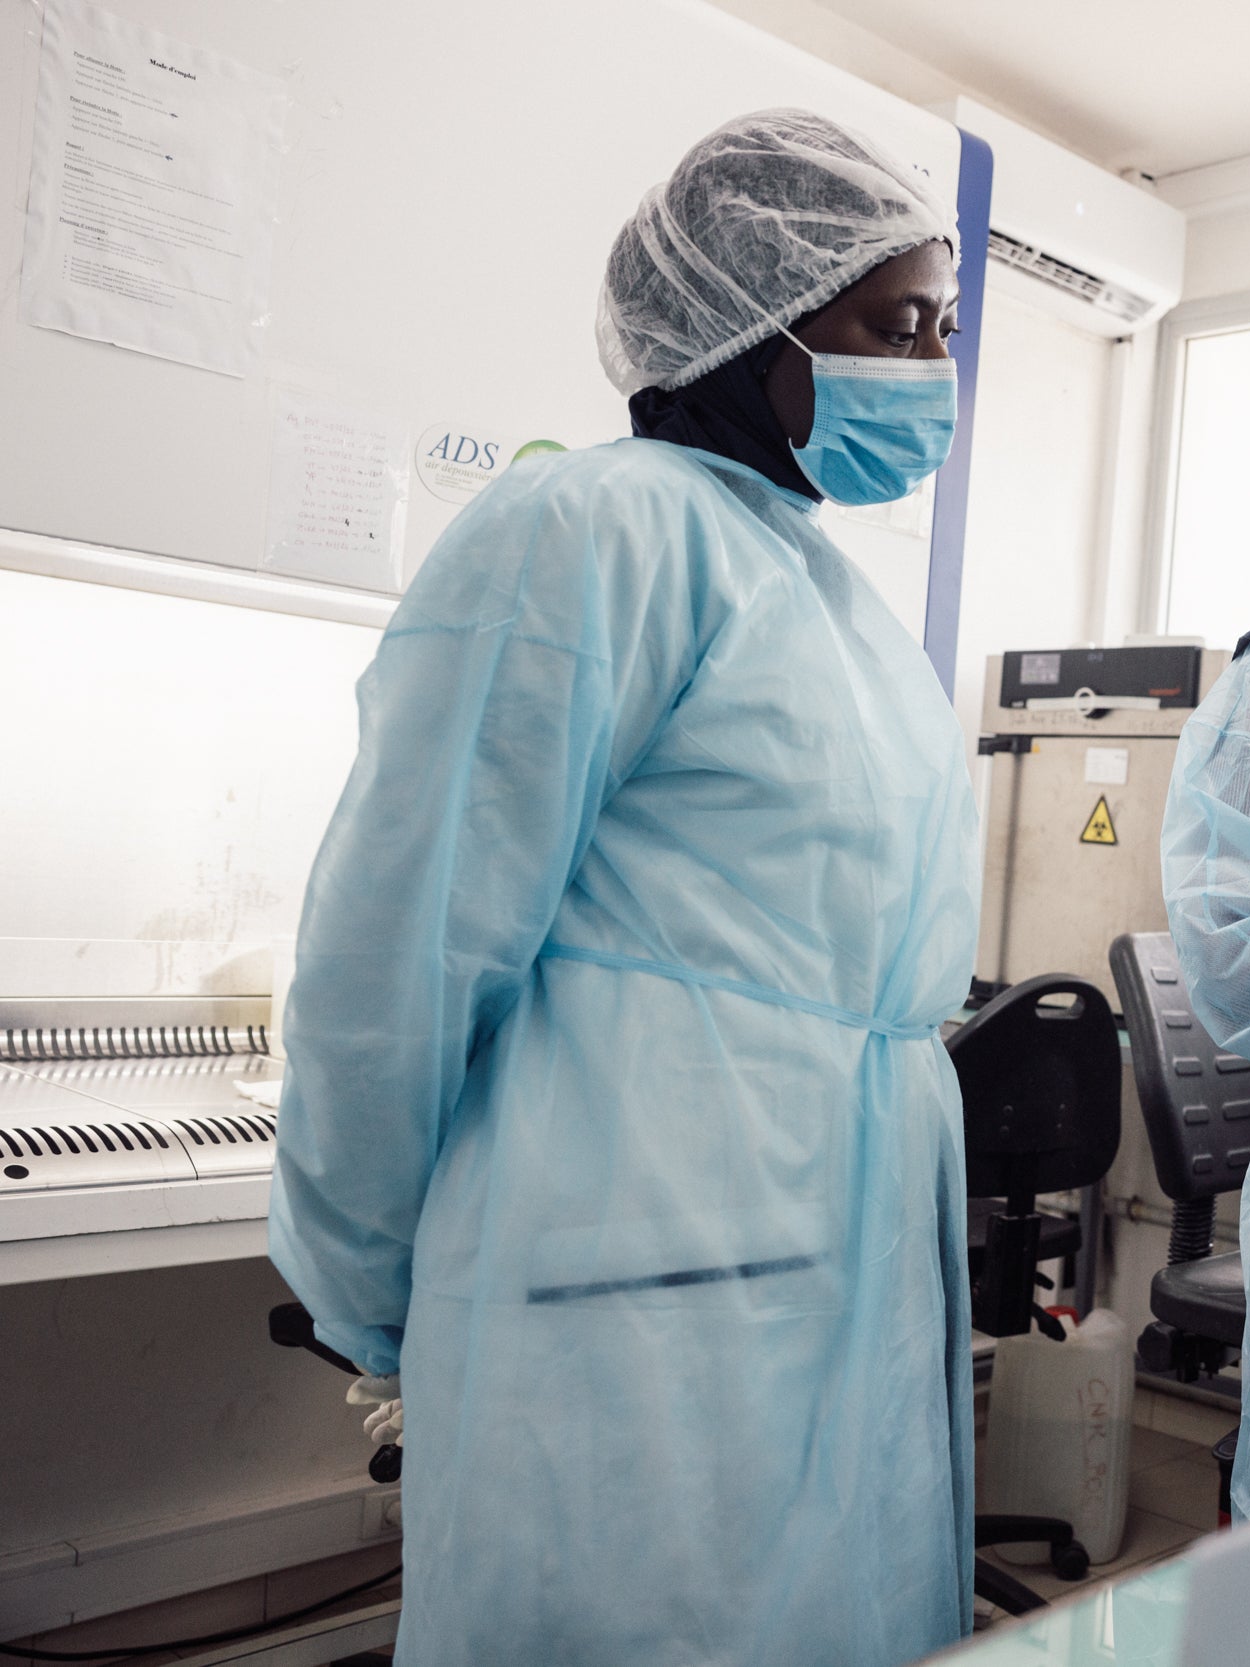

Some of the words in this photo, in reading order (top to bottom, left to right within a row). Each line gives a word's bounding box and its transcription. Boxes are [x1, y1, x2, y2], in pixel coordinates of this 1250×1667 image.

[150, 59, 167, 70] Mode
[168, 66, 196, 80] d'emploi
[427, 432, 499, 470] ADS
[425, 461, 439, 470] air
